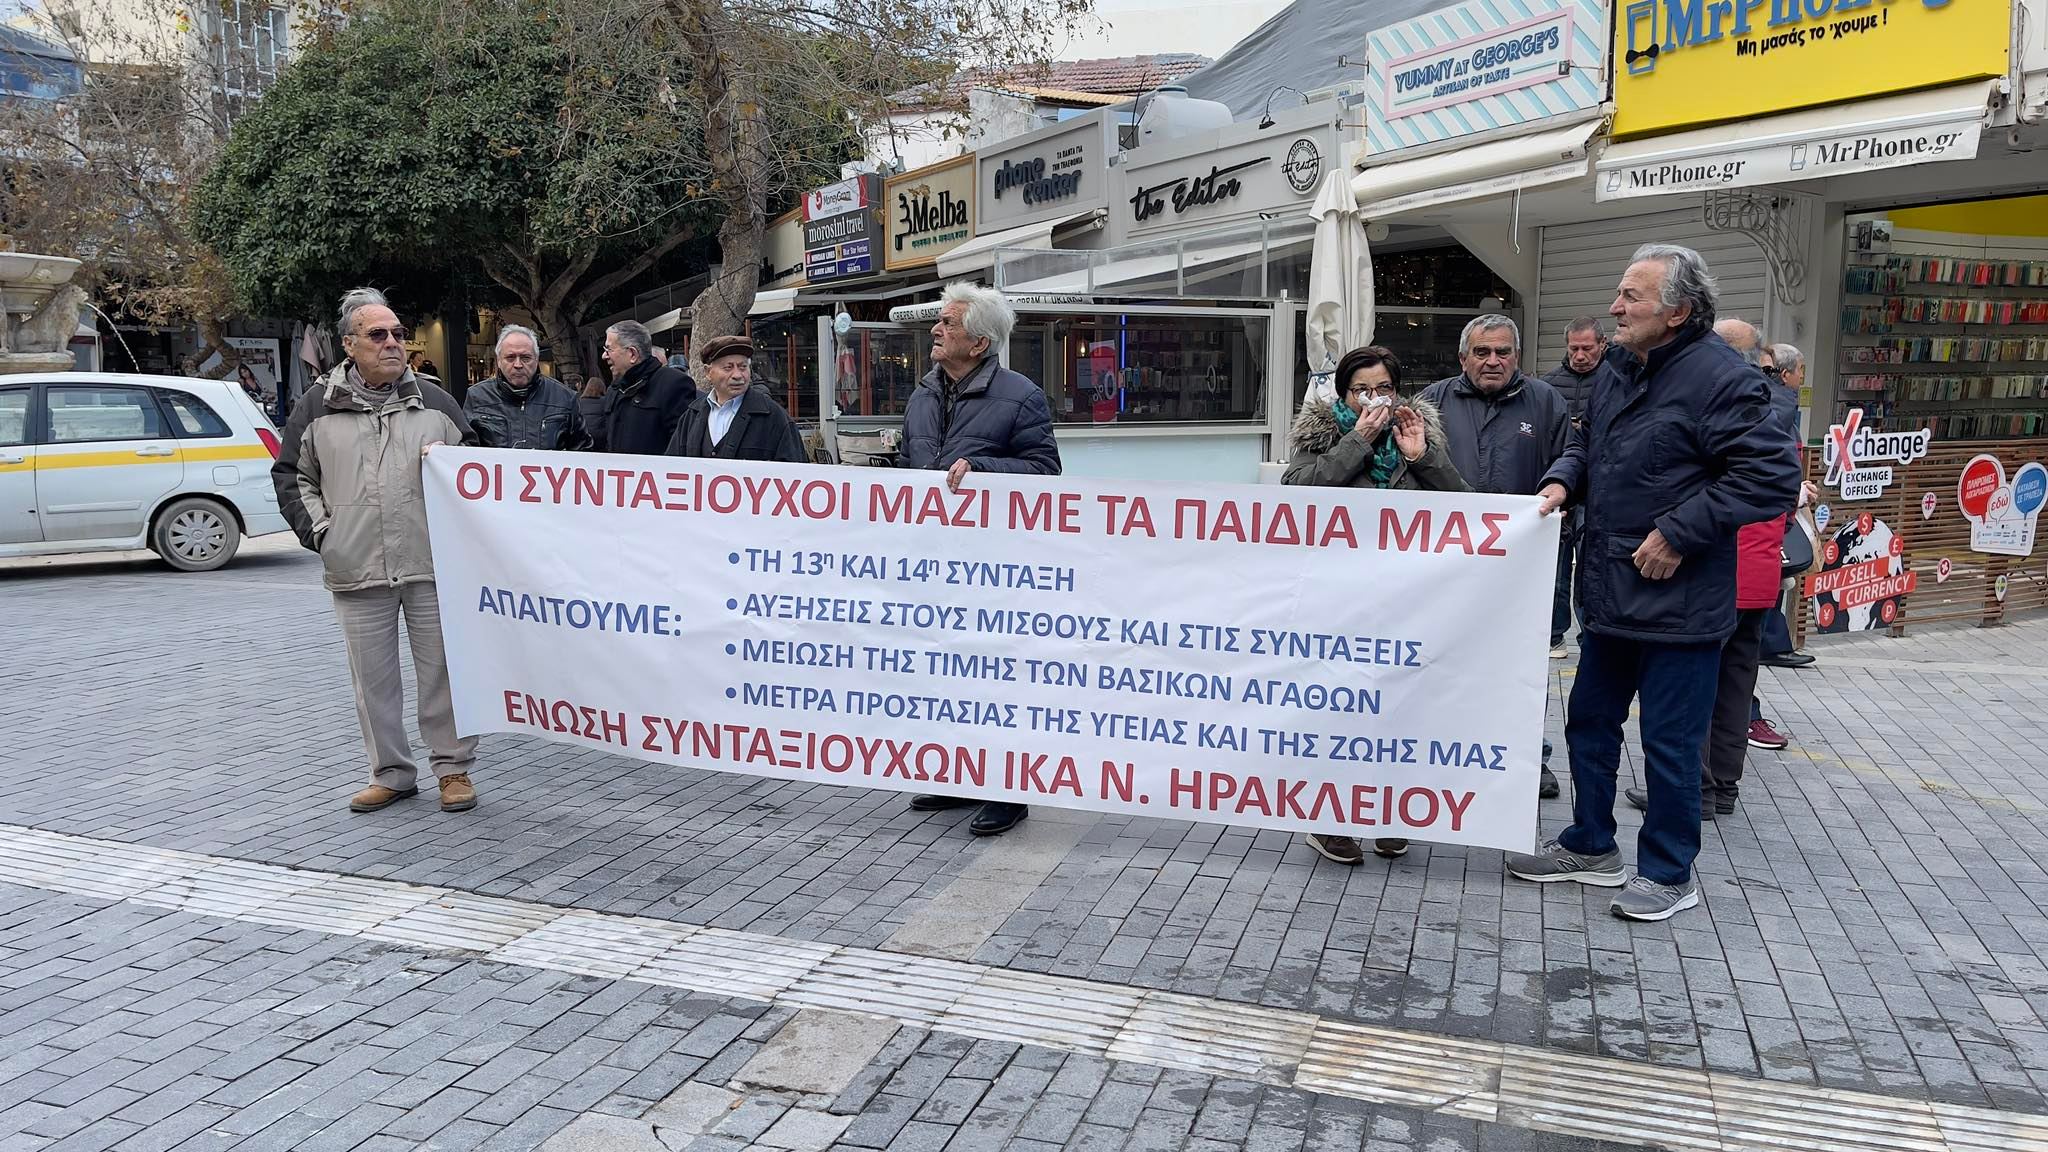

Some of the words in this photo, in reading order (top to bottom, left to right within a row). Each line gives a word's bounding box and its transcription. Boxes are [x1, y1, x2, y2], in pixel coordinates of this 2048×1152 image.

[1394, 58, 1454, 93] YUMMY
[1454, 59, 1470, 77] AT
[1472, 26, 1560, 70] GEORGE'S
[1737, 39, 1757, 56] Μη
[1761, 28, 1805, 55] μασάς
[1809, 26, 1825, 40] το
[1432, 80, 1469, 98] ARTISAN
[1470, 74, 1483, 88] OF
[1484, 68, 1510, 84] TASTE
[1815, 130, 1963, 165] MrPhone.gr
[995, 157, 1045, 200] phone
[1023, 169, 1082, 205] center
[1130, 177, 1188, 221] the
[1172, 156, 1271, 214] Editor
[1629, 160, 1746, 189] MrPhone.gr
[808, 216, 846, 243] morosini
[846, 212, 864, 234] travel
[911, 190, 968, 234] Melba
[1827, 412, 1924, 482] iXchange
[1845, 470, 1889, 483] EXCHANGE
[1845, 484, 1878, 497] OFFICES
[456, 462, 503, 501] ΟΙ
[519, 464, 851, 521] ΣΥΝΤΑΞΙΟΥΧΟΙ
[868, 483, 990, 529] ΜΑΖΙ
[1008, 490, 1082, 534] ΜΕ
[1097, 494, 1156, 538] ΤΑ
[1174, 498, 1358, 549] ΠΑΙΔΙΑ
[1378, 507, 1510, 557] ΜΑΣ
[1991, 494, 2009, 511] εδώ
[745, 547, 782, 573] ΤΗ
[841, 553, 887, 581] ΚΑΙ
[945, 560, 1075, 593] ΣΥΝΤΑΞΗ
[1814, 572, 1841, 593] BUY
[1849, 563, 1877, 584] SELL
[1846, 574, 1910, 605] CURRENCY
[478, 585, 682, 637] ΑΠΑΙΤΟΥΜΕ:
[743, 593, 872, 624] ΑΥΞΗΣΕΙΣ
[880, 601, 968, 632] ΣΤΟΥΣ
[977, 607, 1111, 642] ΜΙΣΘΟΥΣ
[1121, 618, 1168, 647] ΚΑΙ
[1179, 623, 1241, 653] ΣΤΙΣ
[1250, 628, 1423, 667] ΣΥΝΤΑΞΕΙΣ
[743, 638, 854, 669] ΜΕΙΩΣΗ
[863, 646, 916, 674] ΤΗΣ
[925, 651, 1016, 682] ΤΙΜΗΣ
[1026, 659, 1088, 688] ΤΩΝ
[1099, 668, 1232, 702] ΒΑΣΙΚΩΝ
[1242, 678, 1381, 714] ΑΓΑΘΩΝ
[743, 682, 837, 714] ΜΕΤΡΑ
[846, 691, 1017, 729] ΠΡΟΣΤΑΣΙΑΣ
[1027, 706, 1082, 735] ΤΗΣ
[1090, 711, 1188, 746] ΥΓΕΙΑΣ
[1198, 722, 1247, 753] ΚΑΙ
[1259, 728, 1319, 760] ΤΗΣ
[1329, 733, 1418, 764] ΖΩΗΣ
[1429, 740, 1508, 771] ΜΑΣ
[503, 689, 628, 747] ΕΝΩΣΗ
[641, 715, 986, 788] ΣΥΝΤΑΞΙΟΥΧΩΝ
[1004, 749, 1083, 798] ΙΚΑ
[1100, 760, 1149, 804] Ν.
[1169, 767, 1476, 832] ΗΡΑΚΛΕΙΟΥ
